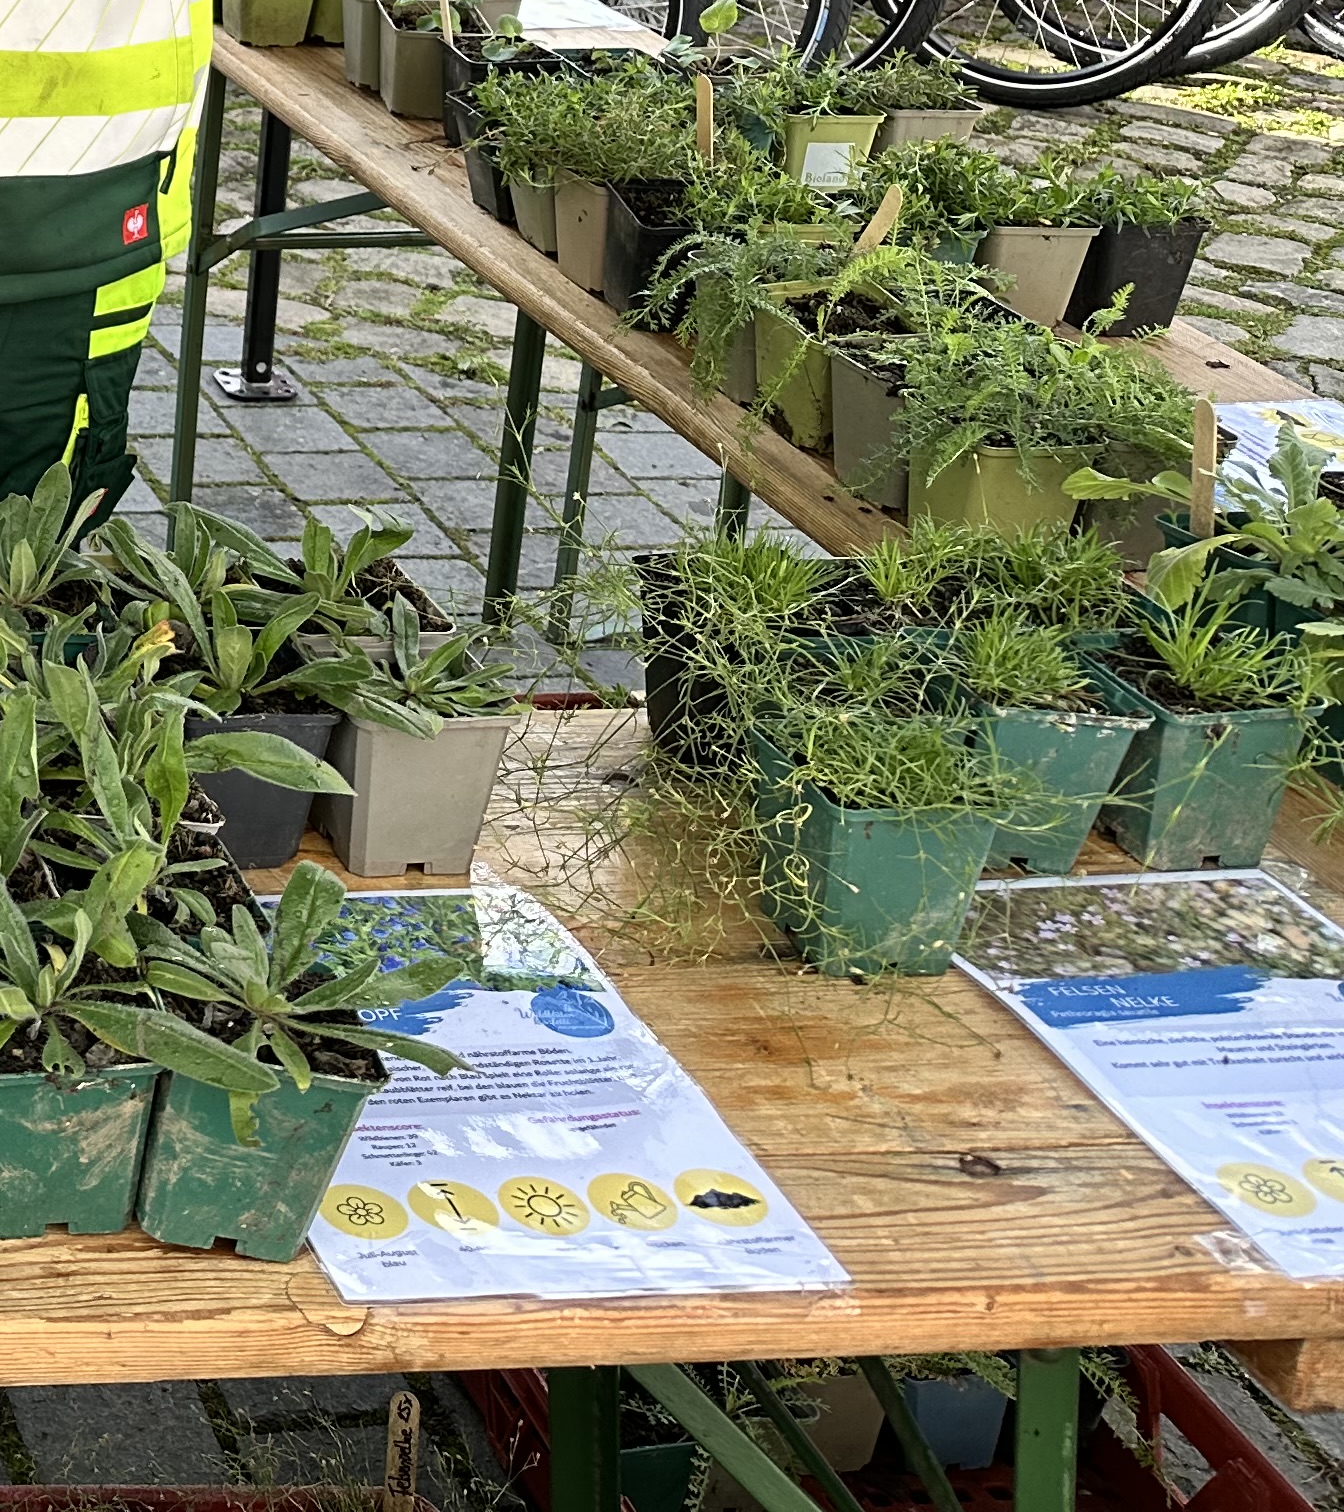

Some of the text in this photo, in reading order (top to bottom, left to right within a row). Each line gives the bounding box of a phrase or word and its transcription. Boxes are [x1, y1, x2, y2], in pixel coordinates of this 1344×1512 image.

[805, 172, 845, 184] Bioland
[1047, 984, 1127, 997] FELSEN
[1109, 995, 1180, 1008] NELKE
[357, 1008, 402, 1023] OPF
